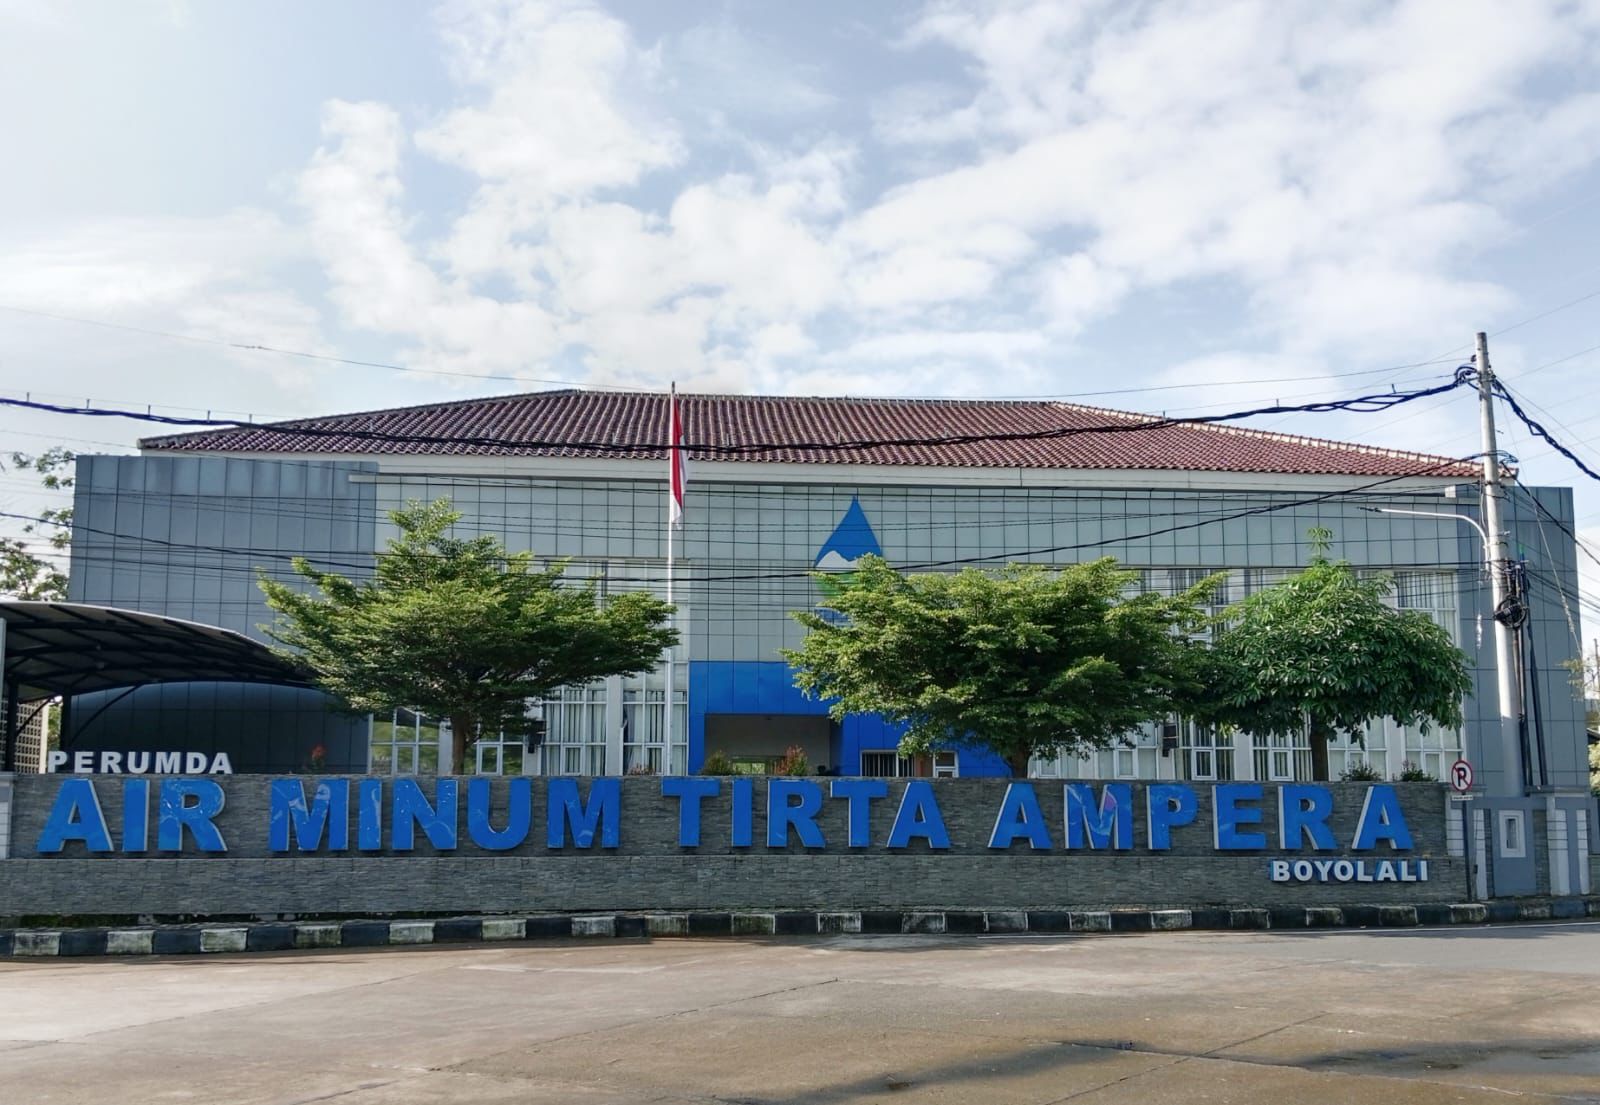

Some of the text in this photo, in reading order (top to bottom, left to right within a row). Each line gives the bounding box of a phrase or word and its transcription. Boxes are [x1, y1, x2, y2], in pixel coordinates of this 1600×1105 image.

[47, 750, 233, 774] PERUMDA
[37, 778, 1414, 853] AIR MINUM TIRTA AMPERA
[1271, 859, 1428, 882] BOYOLALI
